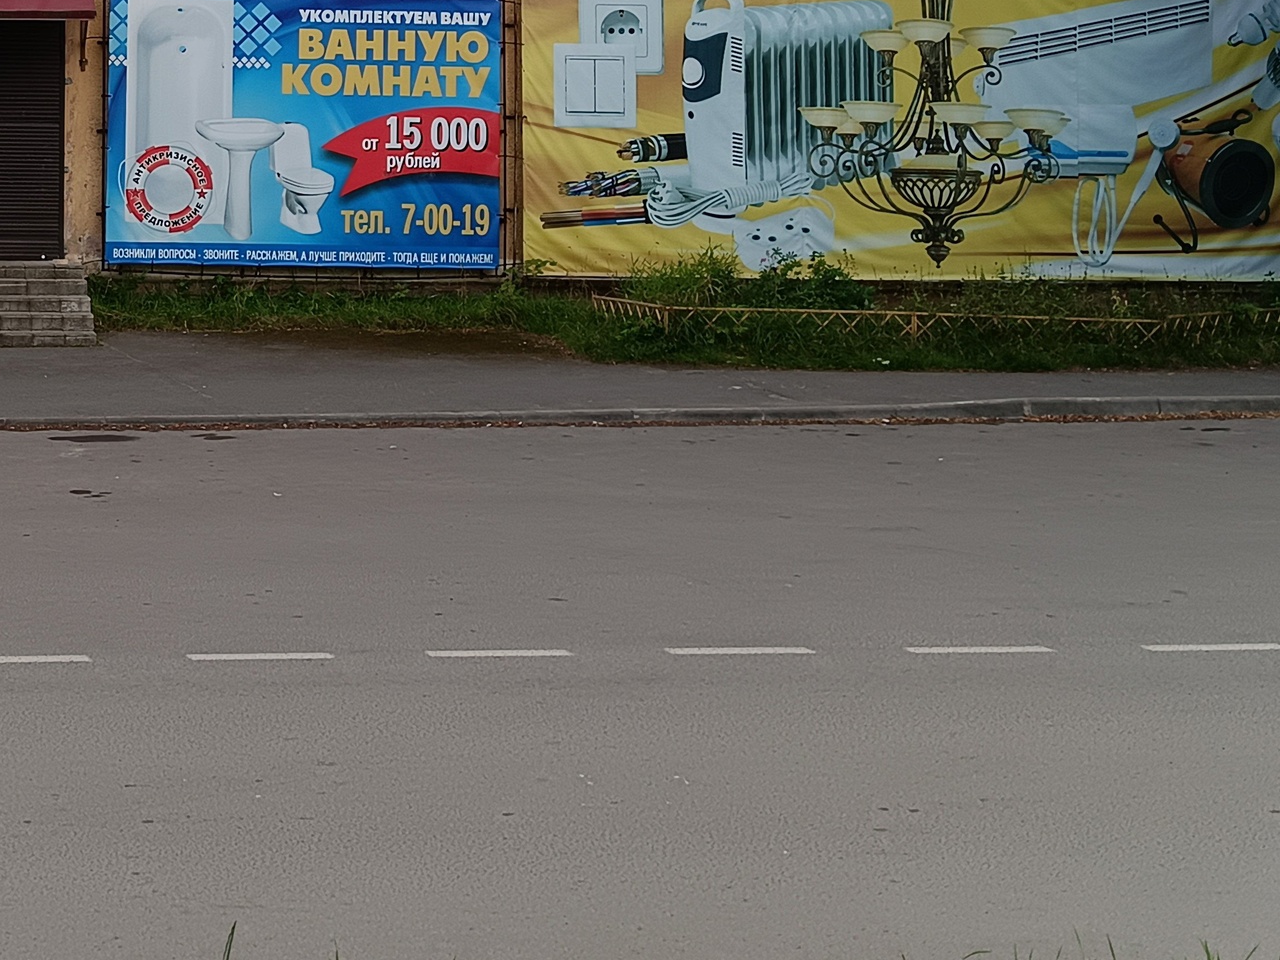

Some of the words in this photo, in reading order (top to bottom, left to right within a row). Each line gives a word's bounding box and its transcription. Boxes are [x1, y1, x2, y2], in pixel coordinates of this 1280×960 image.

[299, 8, 437, 26] УКОМПЛЕКТУЕМ
[440, 10, 491, 27] ВАШУ
[298, 28, 489, 64] ВАННУЮ
[281, 63, 491, 98] КОМНАТУ
[362, 138, 379, 152] от
[385, 116, 422, 151] 15
[431, 116, 487, 152] 000
[133, 151, 206, 185] АНТИКРИЗИСНОЕ
[386, 152, 440, 173] рублей
[135, 201, 203, 227] ПРЕДЛОЖЕНИЕ
[341, 210, 390, 234] тел.
[401, 203, 490, 237] 7-00-19
[113, 248, 156, 259] ВОЗНИКЛИ
[158, 249, 196, 259] ВОПРОСЫ
[203, 249, 239, 260] ЗВОНИТЕ
[246, 250, 299, 262] РАССКАЖЕМ,
[300, 251, 307, 261] А
[308, 251, 337, 262] ЛУЧШЕ
[339, 251, 385, 264] ПРИХОДИТЕ
[393, 252, 419, 264] ТОГДА
[420, 253, 438, 265] ЕЩЕ
[440, 253, 447, 263] И
[448, 253, 493, 264] ПОКАЖЕМ!
